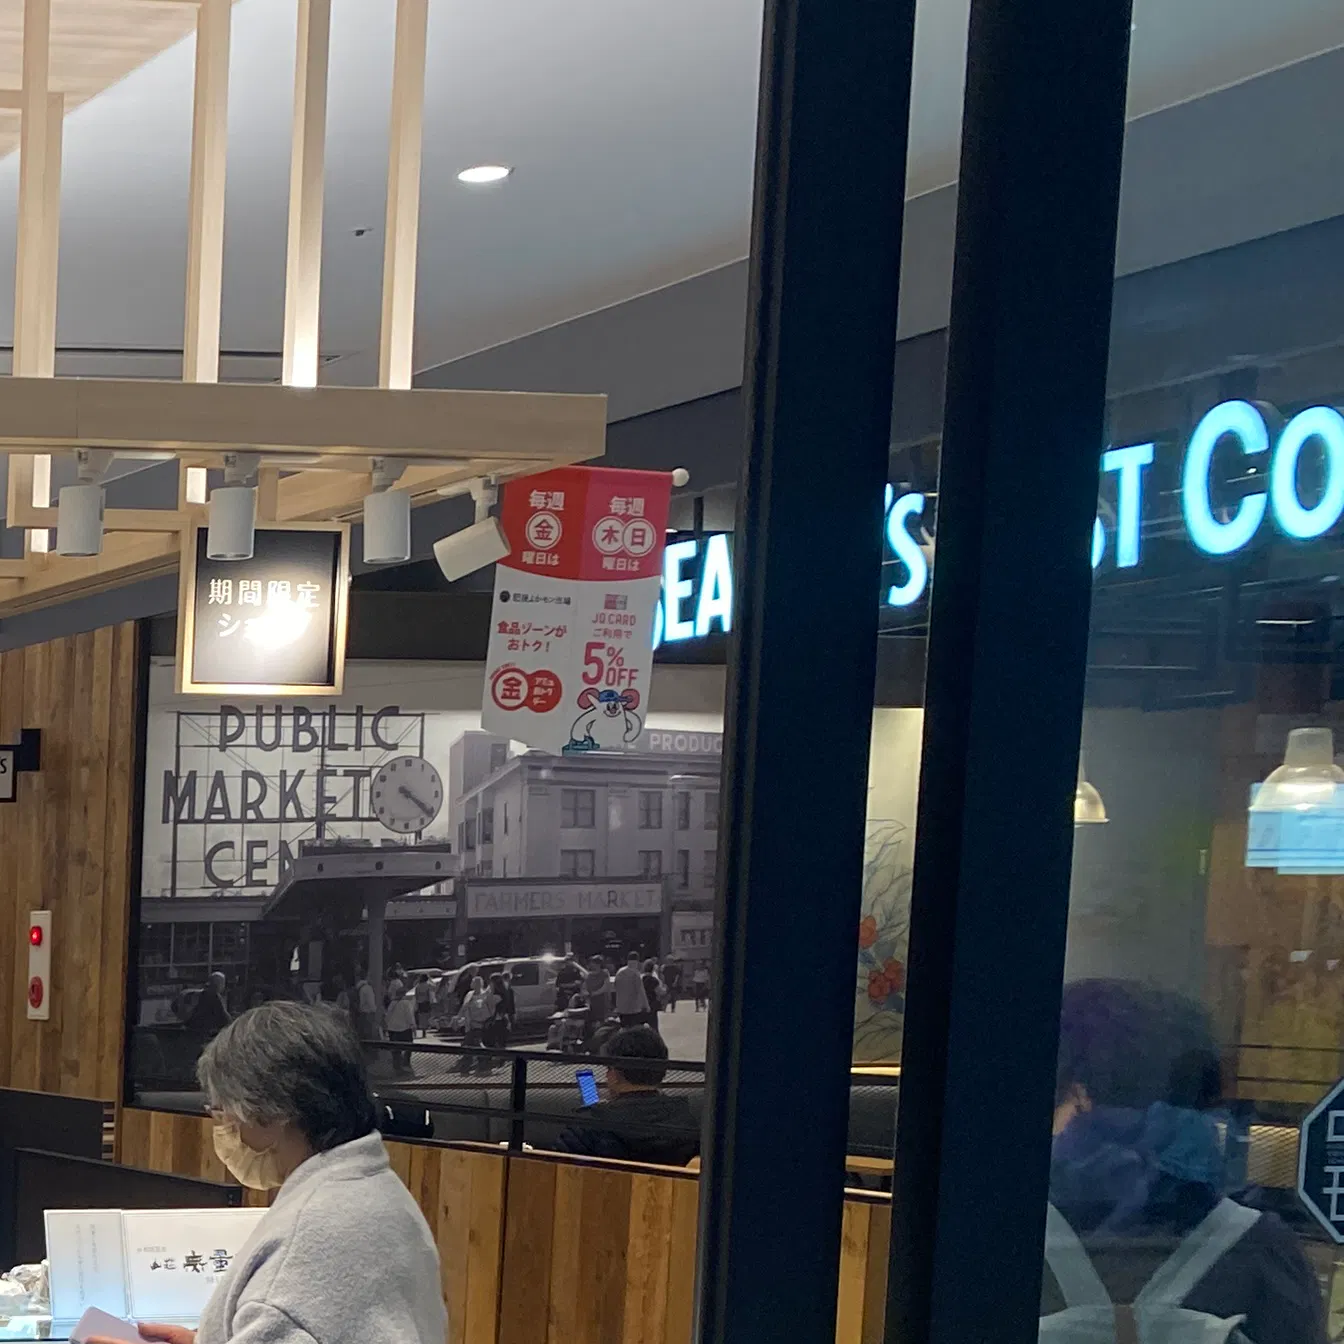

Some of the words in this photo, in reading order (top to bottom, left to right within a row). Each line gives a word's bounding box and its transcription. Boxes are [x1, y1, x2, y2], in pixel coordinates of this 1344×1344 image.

[529, 489, 565, 510] 毎週
[609, 496, 645, 516] 毎週
[534, 519, 554, 541] 金
[522, 551, 561, 566] 曜日は
[602, 556, 640, 572] 曜日は
[208, 578, 321, 608] 期間限定
[653, 534, 734, 650] EA
[497, 620, 568, 638] 食品ゾーンが
[608, 613, 636, 626] CARD
[605, 667, 639, 688] OFF
[219, 705, 400, 753] PUBLIC
[161, 769, 373, 824] MARKET
